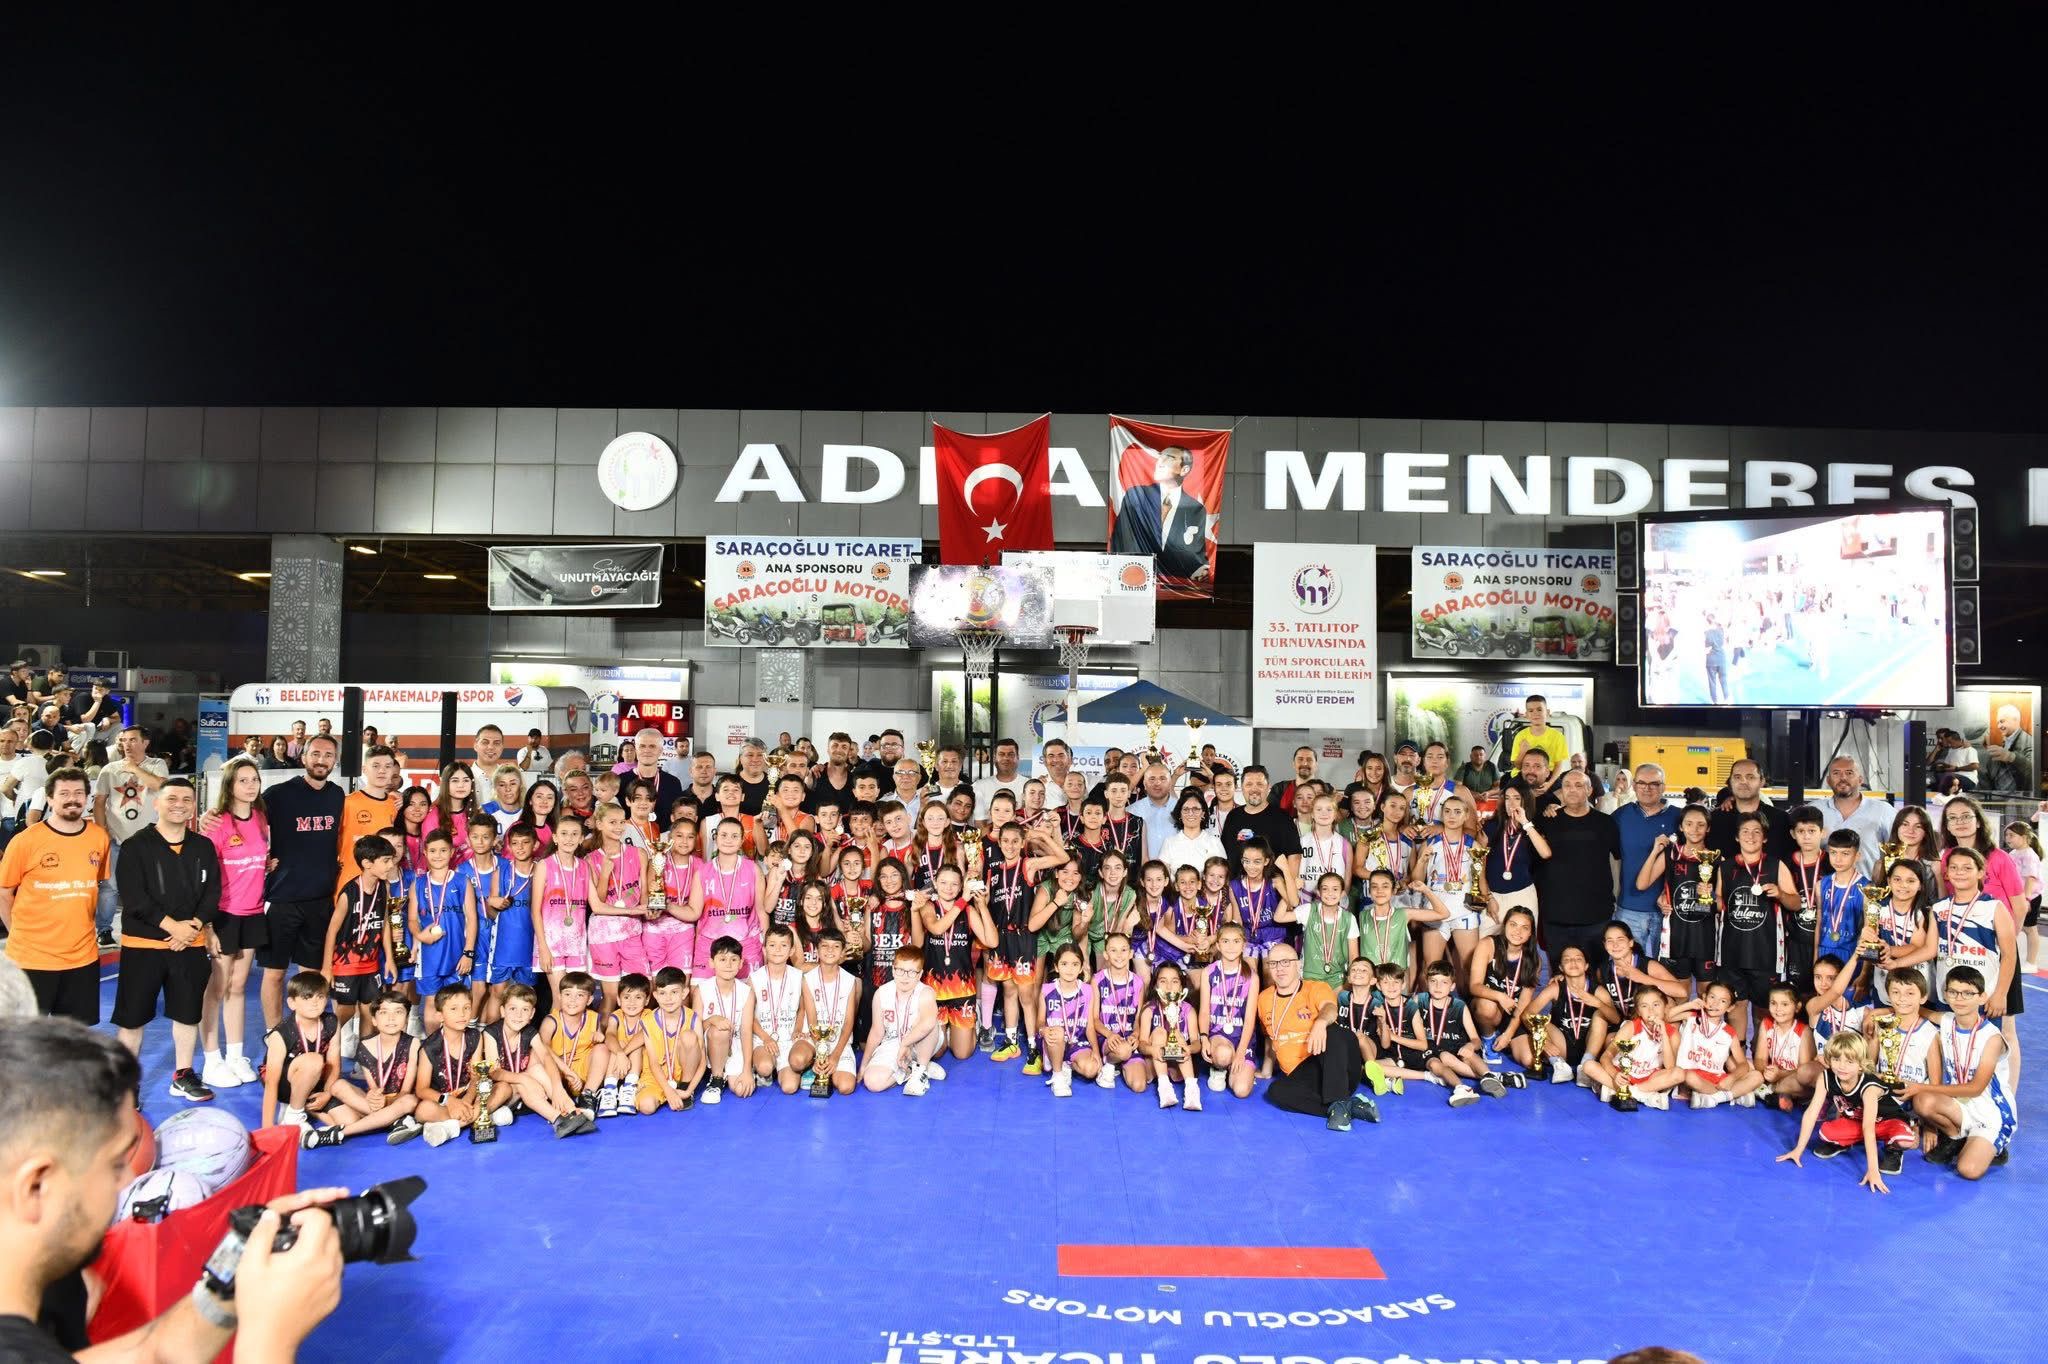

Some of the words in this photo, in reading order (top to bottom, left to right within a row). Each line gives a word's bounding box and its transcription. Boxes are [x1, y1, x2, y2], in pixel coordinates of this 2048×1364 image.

[715, 539, 829, 558] SARAÇOĞLU
[1421, 551, 1538, 569] SARAÇOĞLU
[765, 564, 792, 573] ANA
[796, 564, 863, 574] SPONSORU
[560, 569, 660, 582] UNUTMAYACAĞIZ
[1473, 576, 1500, 584] ANA
[1504, 576, 1572, 586] SPONSORU
[713, 577, 827, 614] SARAÇOĞLU
[834, 579, 909, 615] MOTORS
[811, 594, 818, 602] S
[1420, 589, 1537, 624] SARAÇOĞLU
[1521, 606, 1528, 614] S
[1268, 622, 1290, 633] 33.
[1295, 622, 1359, 633] TATLITOP
[1261, 637, 1366, 649] TURNUVASINDA
[1264, 655, 1288, 666] TÜM
[1291, 658, 1365, 667] SPORCULARA
[1258, 670, 1321, 680] BAŞARILAR
[1324, 669, 1372, 680] DİLERİM
[1275, 693, 1313, 705] ŞÜKRÜ
[1316, 696, 1355, 705] ERDEM
[626, 705, 640, 718] A
[642, 703, 667, 716] 00:00
[671, 706, 684, 719] B
[200, 718, 227, 727] Sultan
[622, 720, 629, 732] 0
[667, 721, 675, 734] 0
[296, 816, 335, 832] MKP
[1302, 847, 1313, 858] 00
[1462, 918, 1469, 930] 7
[708, 1002, 715, 1015] 9
[1048, 1000, 1060, 1011] 05
[884, 1010, 895, 1023] 23
[1002, 1289, 1183, 1326] MOTORS
[1204, 1293, 1458, 1330] SARAÇOĞLU
